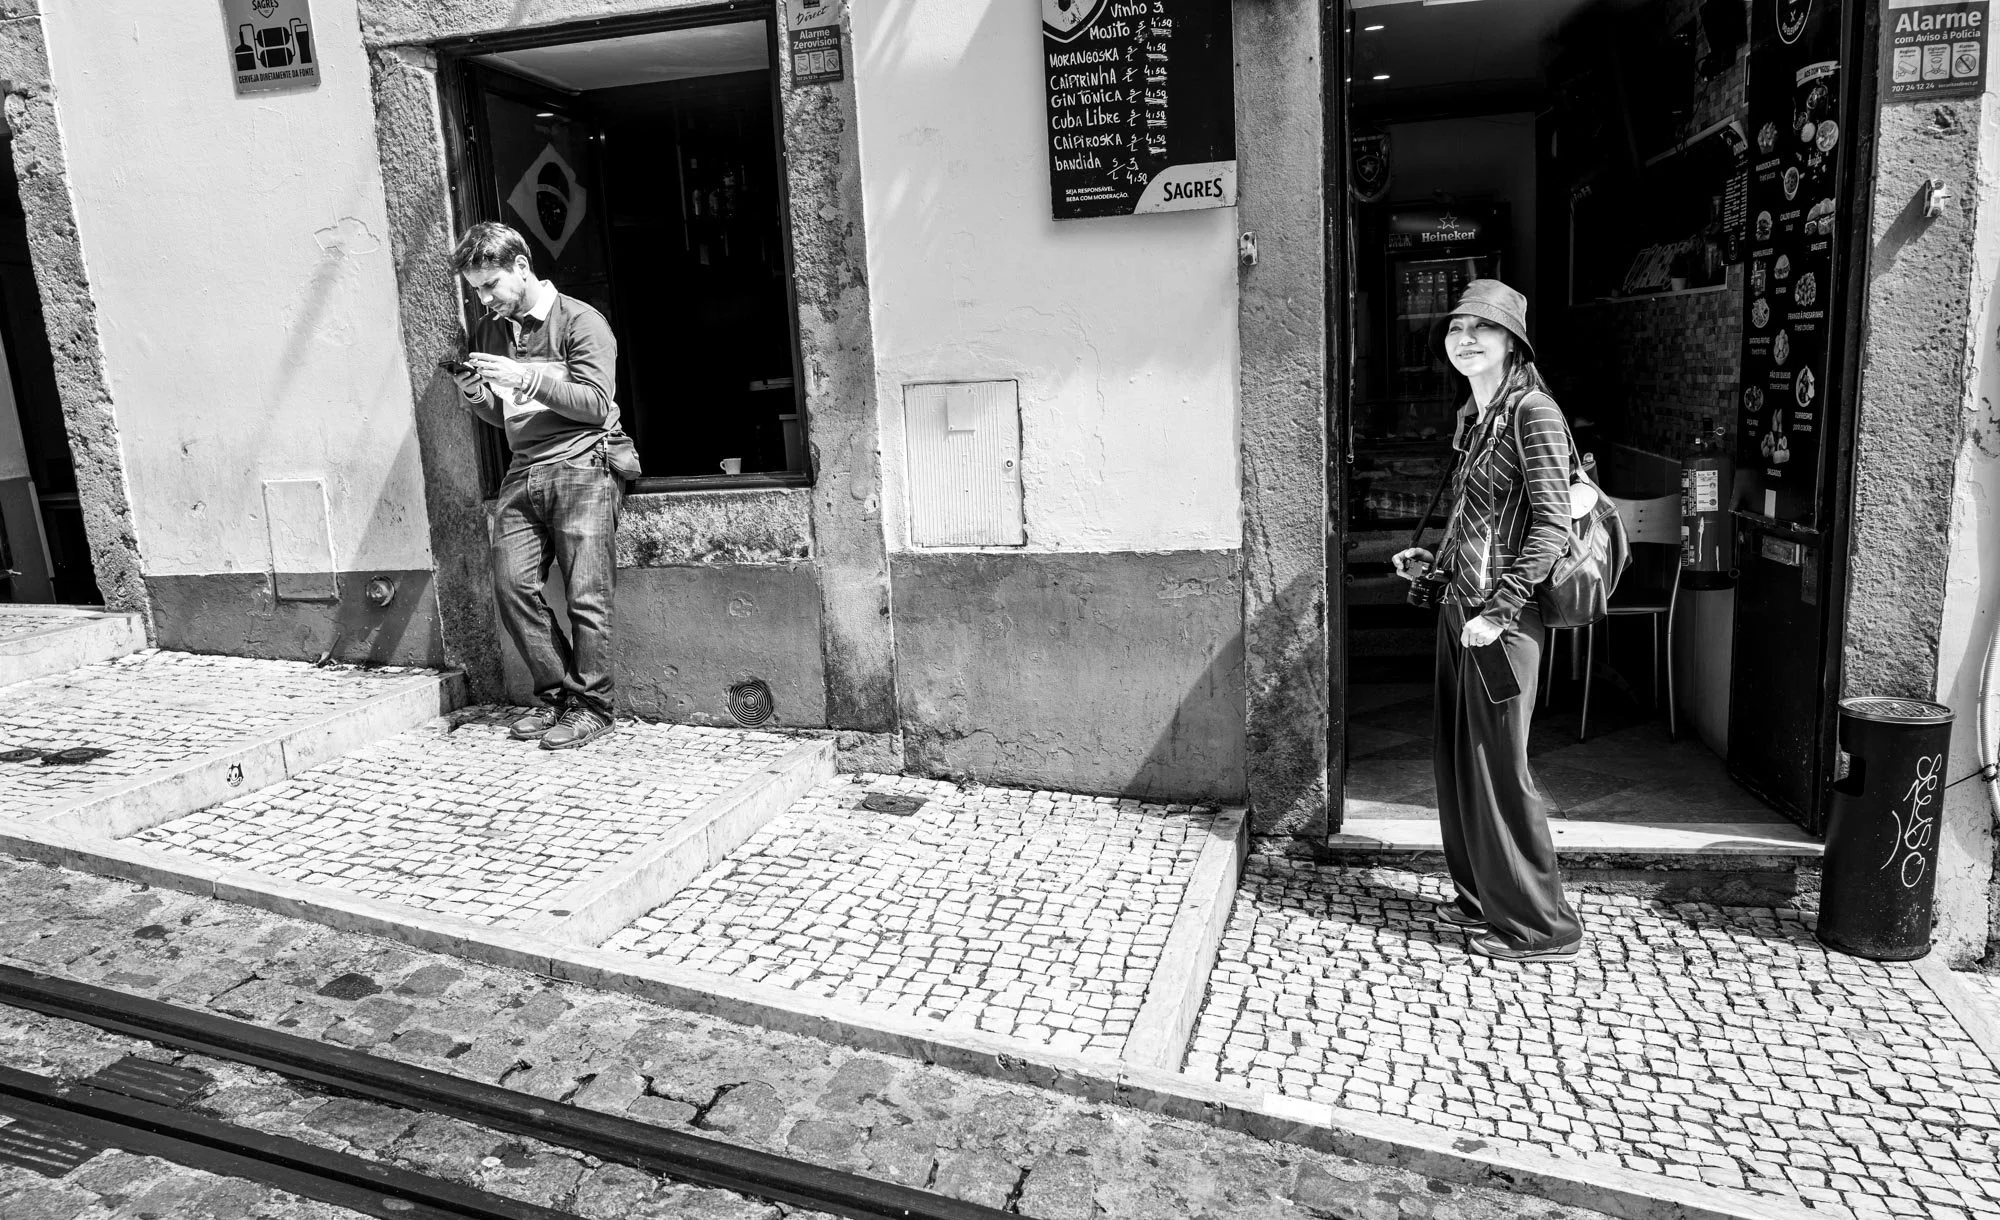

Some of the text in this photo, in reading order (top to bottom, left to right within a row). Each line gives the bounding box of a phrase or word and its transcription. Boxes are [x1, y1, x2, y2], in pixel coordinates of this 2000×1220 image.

[252, 0, 279, 10] SAGRES
[1895, 11, 1982, 33] Alarme
[800, 29, 830, 40] Alarme
[1894, 36, 1914, 44] com
[1916, 32, 1940, 43] Aviso
[1950, 29, 1981, 39] Polícia
[793, 36, 838, 50] Zerovision
[238, 67, 314, 84] CERVEJA DIRETAMENTE DA FONTE
[1892, 85, 1905, 93] 707
[1163, 178, 1223, 202] SAGRES
[1421, 230, 1476, 243] Heineken
